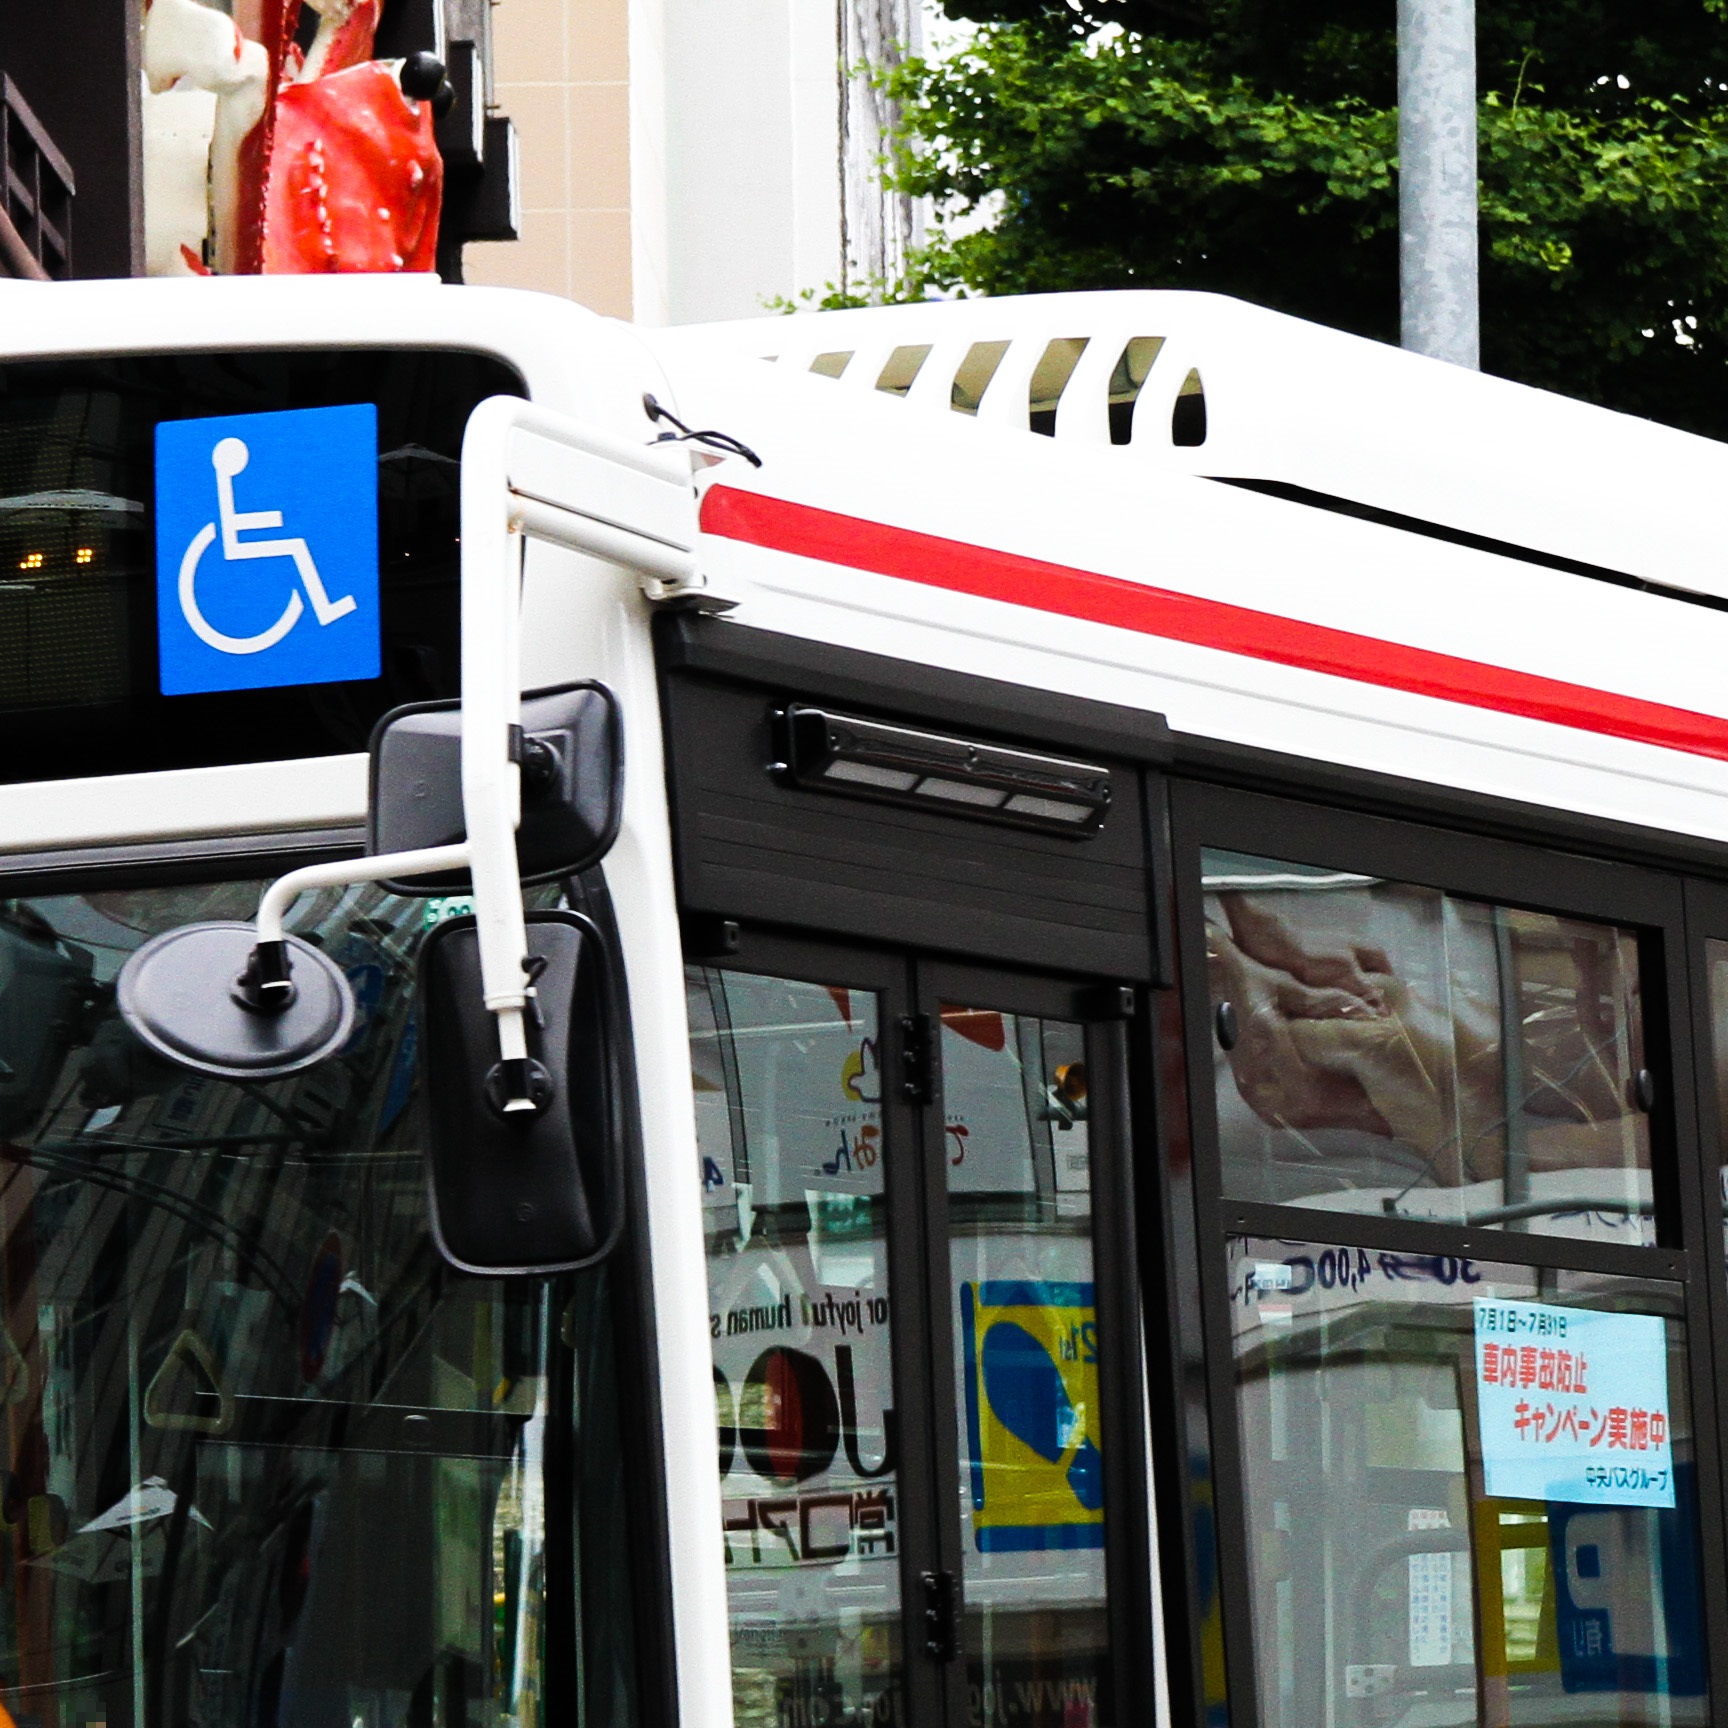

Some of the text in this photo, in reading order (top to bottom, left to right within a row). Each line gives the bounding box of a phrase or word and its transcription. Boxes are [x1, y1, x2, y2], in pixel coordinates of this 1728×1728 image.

[1483, 1343, 1588, 1394] 車内事故防止
[1514, 1398, 1666, 1451] キャンペーン実施中
[1586, 1467, 1668, 1491] 中央バスグループ
